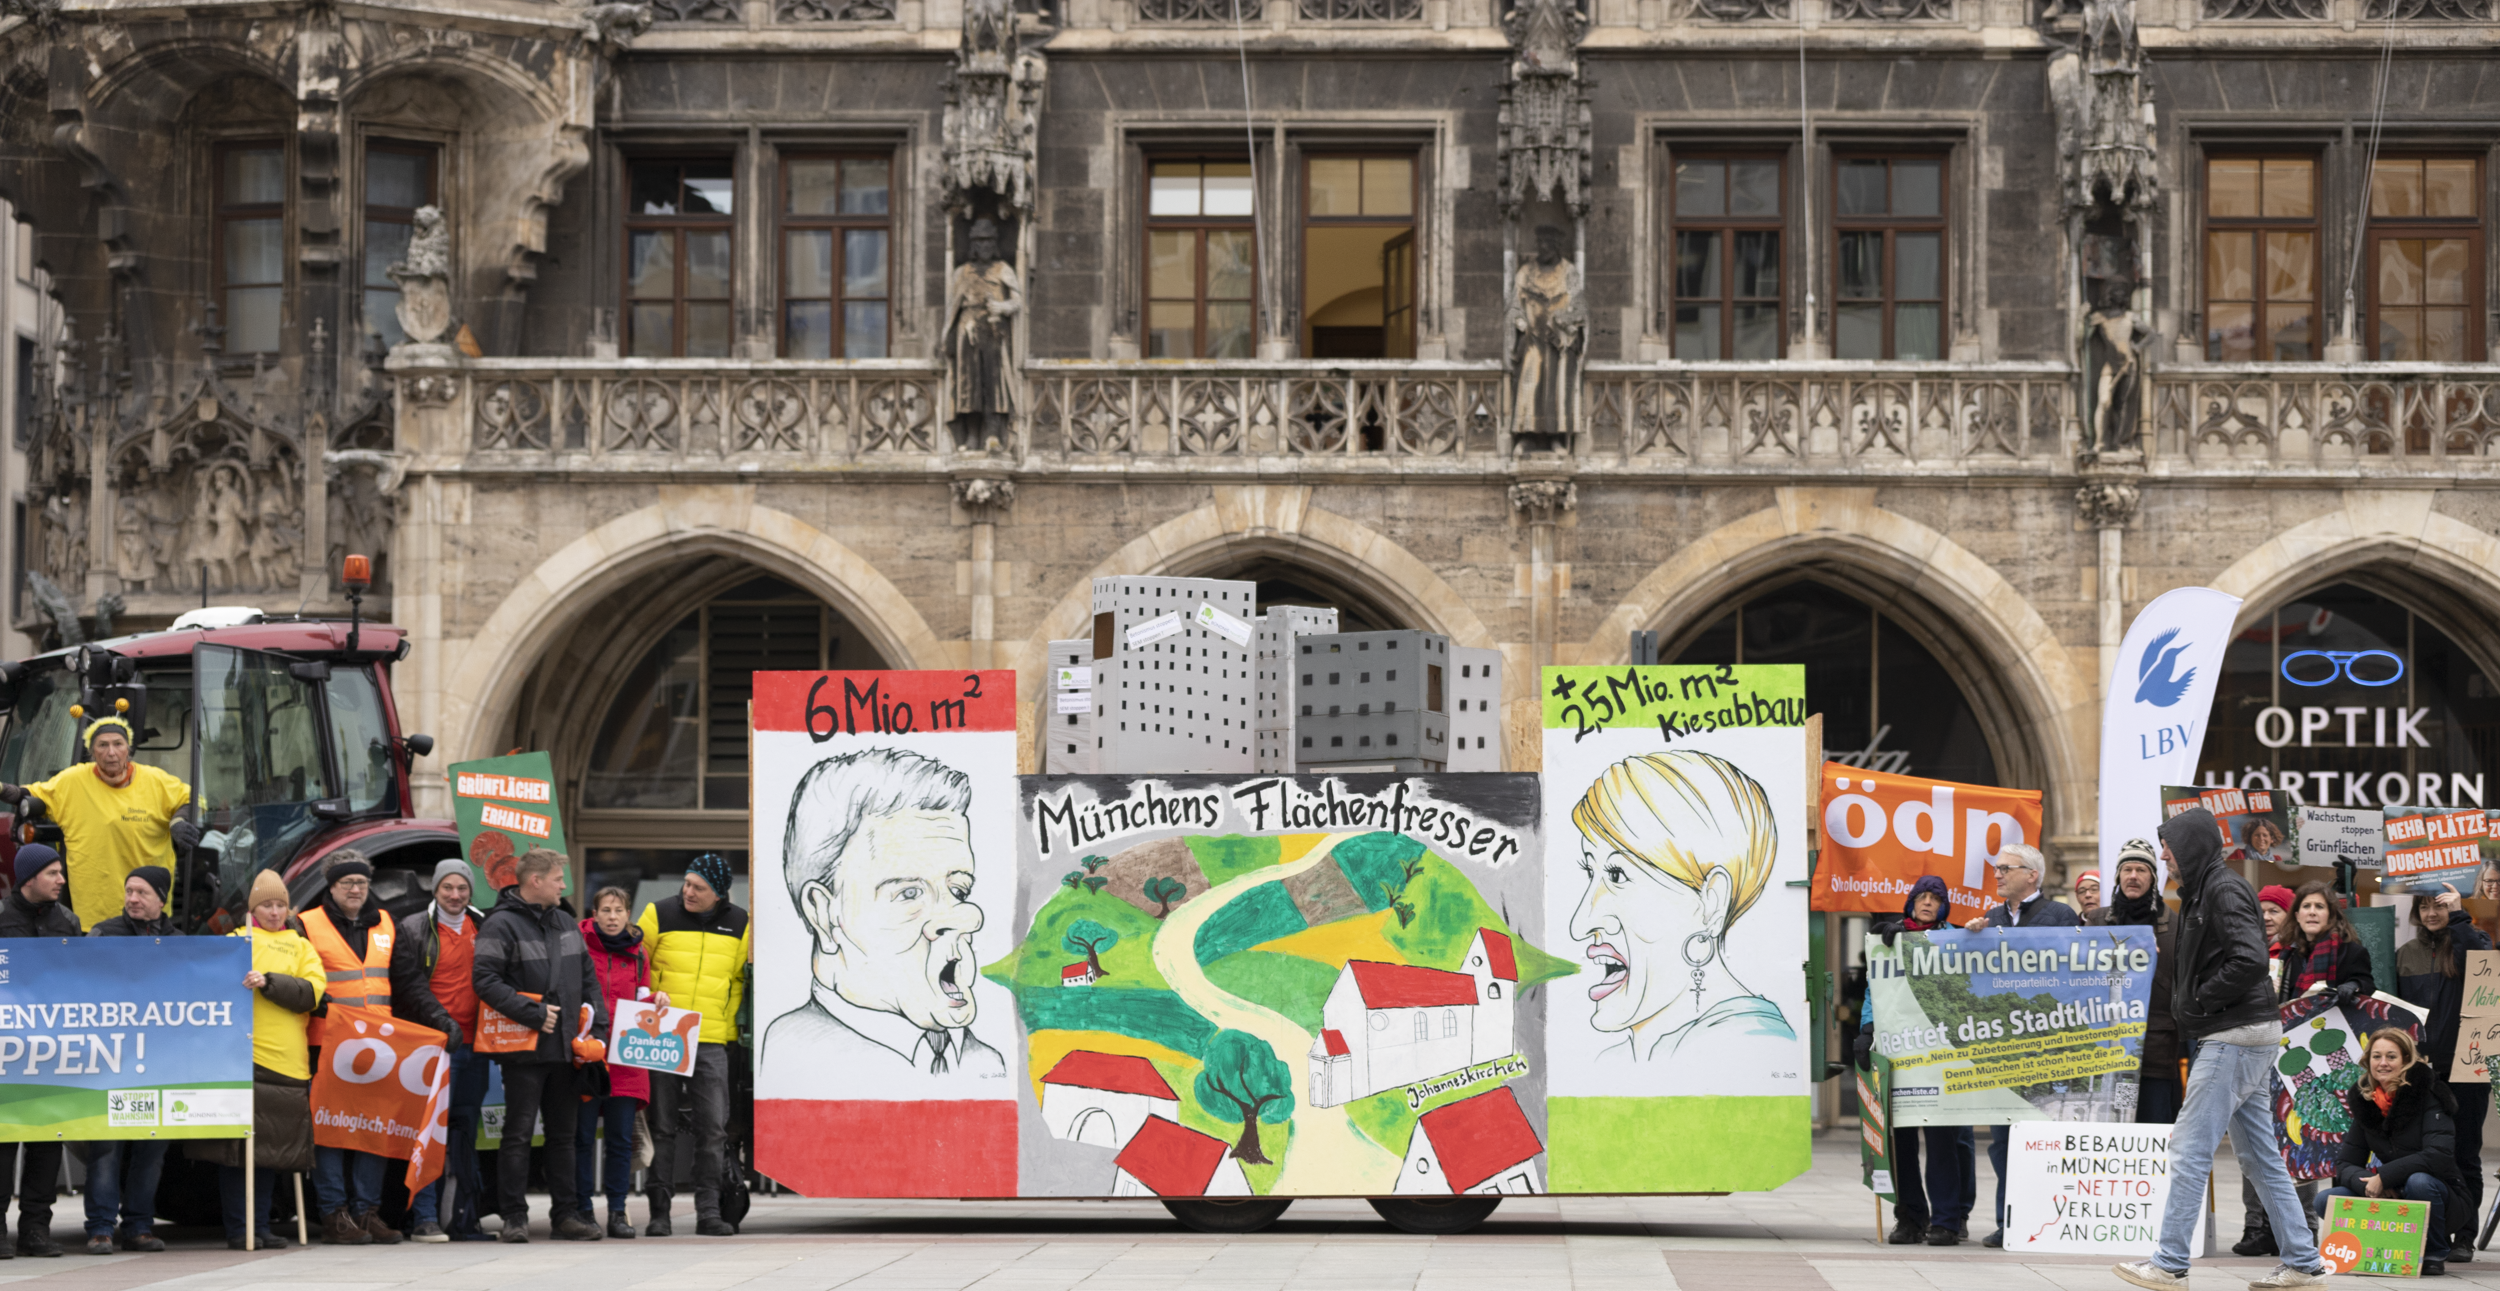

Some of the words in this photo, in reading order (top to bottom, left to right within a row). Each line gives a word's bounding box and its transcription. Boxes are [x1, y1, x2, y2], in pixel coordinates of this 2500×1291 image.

[1657, 691, 1805, 742] Kiesabbau
[2255, 706, 2431, 748] OPTIK
[2139, 720, 2195, 760] LBV
[457, 774, 550, 801] GRÜNFLÄCHEN
[2201, 790, 2246, 815] RAUM
[2248, 792, 2272, 810] FÜR
[481, 806, 549, 836] ERHALTEN.
[1038, 784, 1219, 854] Münchens
[1233, 779, 1519, 863] Flächenfresser
[2307, 810, 2356, 823] Wachstum
[2386, 818, 2426, 841] MEHR
[2426, 814, 2487, 841] PLÄTZE
[1825, 777, 2024, 890] ödp
[2341, 826, 2374, 836] stoppen
[2306, 838, 2375, 854] Grünflächen
[2386, 844, 2480, 873] DURCHATMEN
[1912, 940, 2149, 976] München-Liste
[1992, 977, 2059, 990] überparteilich
[2069, 976, 2132, 989] unabhängig
[1880, 1022, 1950, 1054] Rettet
[1958, 1016, 2004, 1042] das
[2009, 997, 2145, 1035] Stadtklima
[2471, 1028, 2481, 1039] in
[629, 1036, 661, 1046] Danke
[663, 1038, 676, 1047] für
[1896, 1056, 1923, 1068] sagen
[1957, 1050, 1968, 1058] zu
[1972, 1041, 2042, 1056] Zubetonierung
[2044, 1036, 2062, 1046] und
[623, 1046, 679, 1063] 60.000
[1945, 1069, 1972, 1079] Denn
[1976, 1062, 2020, 1075] München
[2023, 1060, 2034, 1069] ist
[2037, 1057, 2063, 1067] schon
[2066, 1052, 2091, 1063] heute
[2094, 1050, 2107, 1058] die
[1406, 1061, 1527, 1108] Johanneskirchen
[1947, 1078, 1995, 1092] stärksten
[1998, 1071, 2048, 1085] versiegelte
[2051, 1068, 2074, 1078] Stadt
[2077, 1059, 2136, 1074] Deutschlands
[123, 1092, 155, 1101] STOPPT
[130, 1101, 155, 1112] SEM
[111, 1112, 155, 1121] WAHNSINN
[2026, 1140, 2061, 1151] MEHR
[2065, 1135, 2172, 1153] BEBAUUN
[2047, 1162, 2058, 1173] in
[2061, 1156, 2167, 1176] MÜNCHEN
[2054, 1195, 2152, 1219] VERLUST
[2060, 1224, 2088, 1240] AN
[2094, 1224, 2158, 1242] GRÜN.
[2335, 1217, 2356, 1228] WIR
[2361, 1219, 2417, 1233] BRAUCHEN
[2325, 1243, 2356, 1264] ödp
[2366, 1247, 2412, 1261] BÄUME
[2364, 1261, 2397, 1274] DANKE
